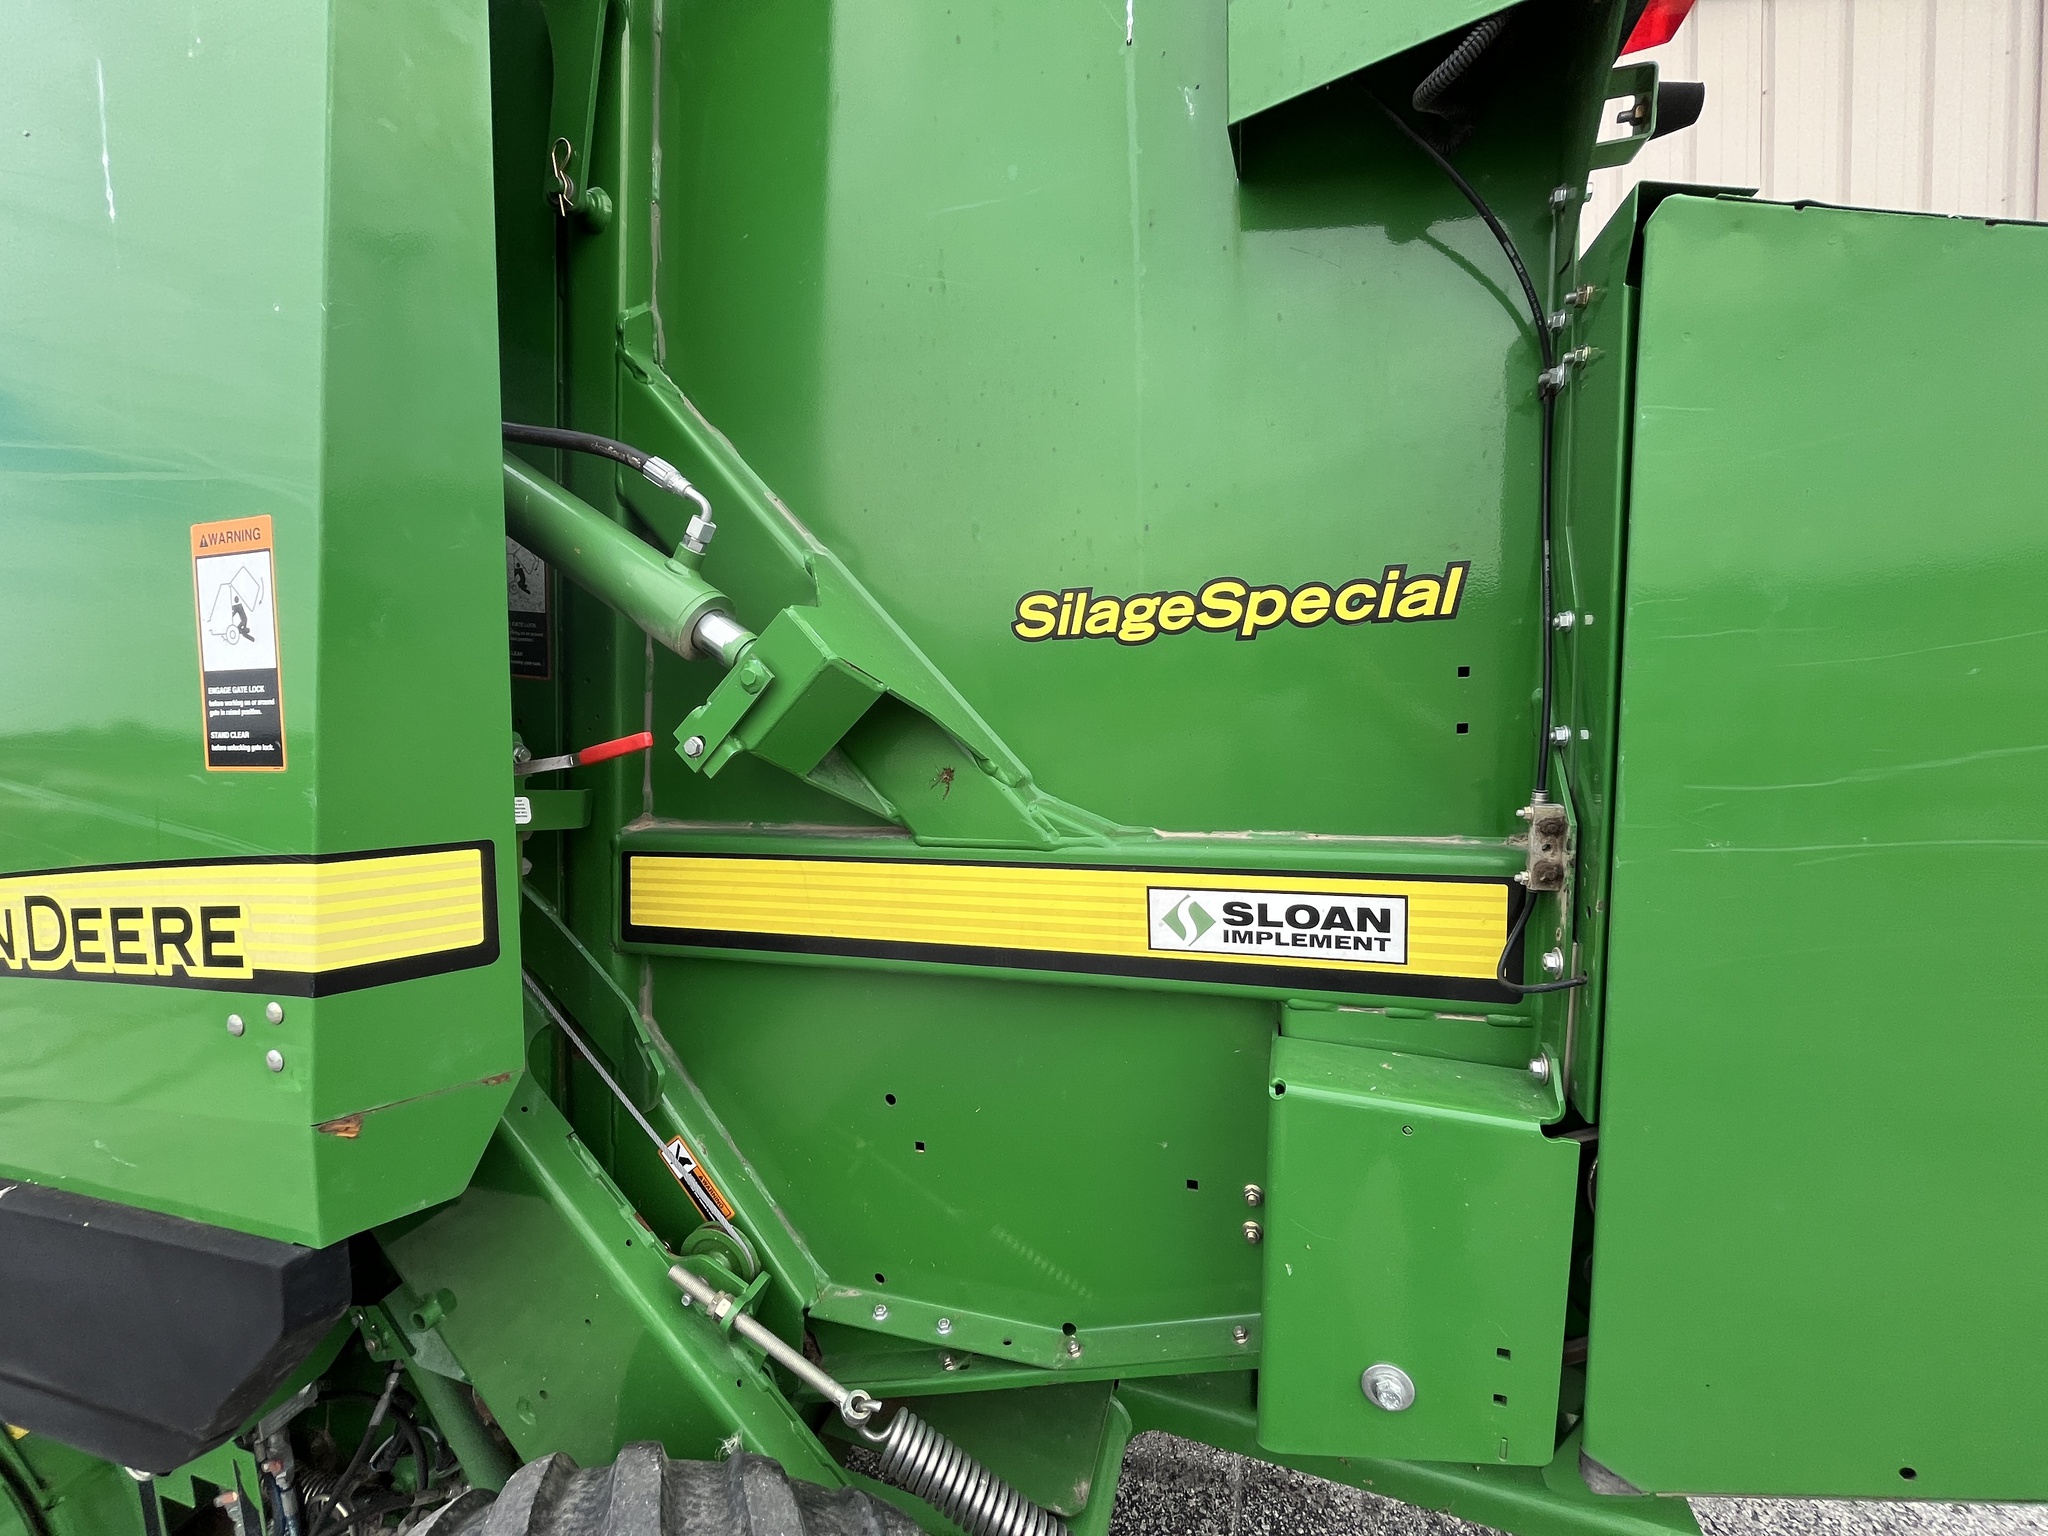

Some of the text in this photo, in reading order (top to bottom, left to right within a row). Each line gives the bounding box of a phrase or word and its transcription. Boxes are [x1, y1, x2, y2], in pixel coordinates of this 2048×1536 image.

[207, 527, 261, 546] WARNING
[1013, 564, 1467, 643] SilageSpecial
[249, 685, 265, 693] LOCK
[24, 894, 245, 968] DEERE
[1221, 900, 1392, 934] SLOAN
[1222, 929, 1392, 952] IMPLEMENT
[702, 1179, 725, 1209] WARNING
